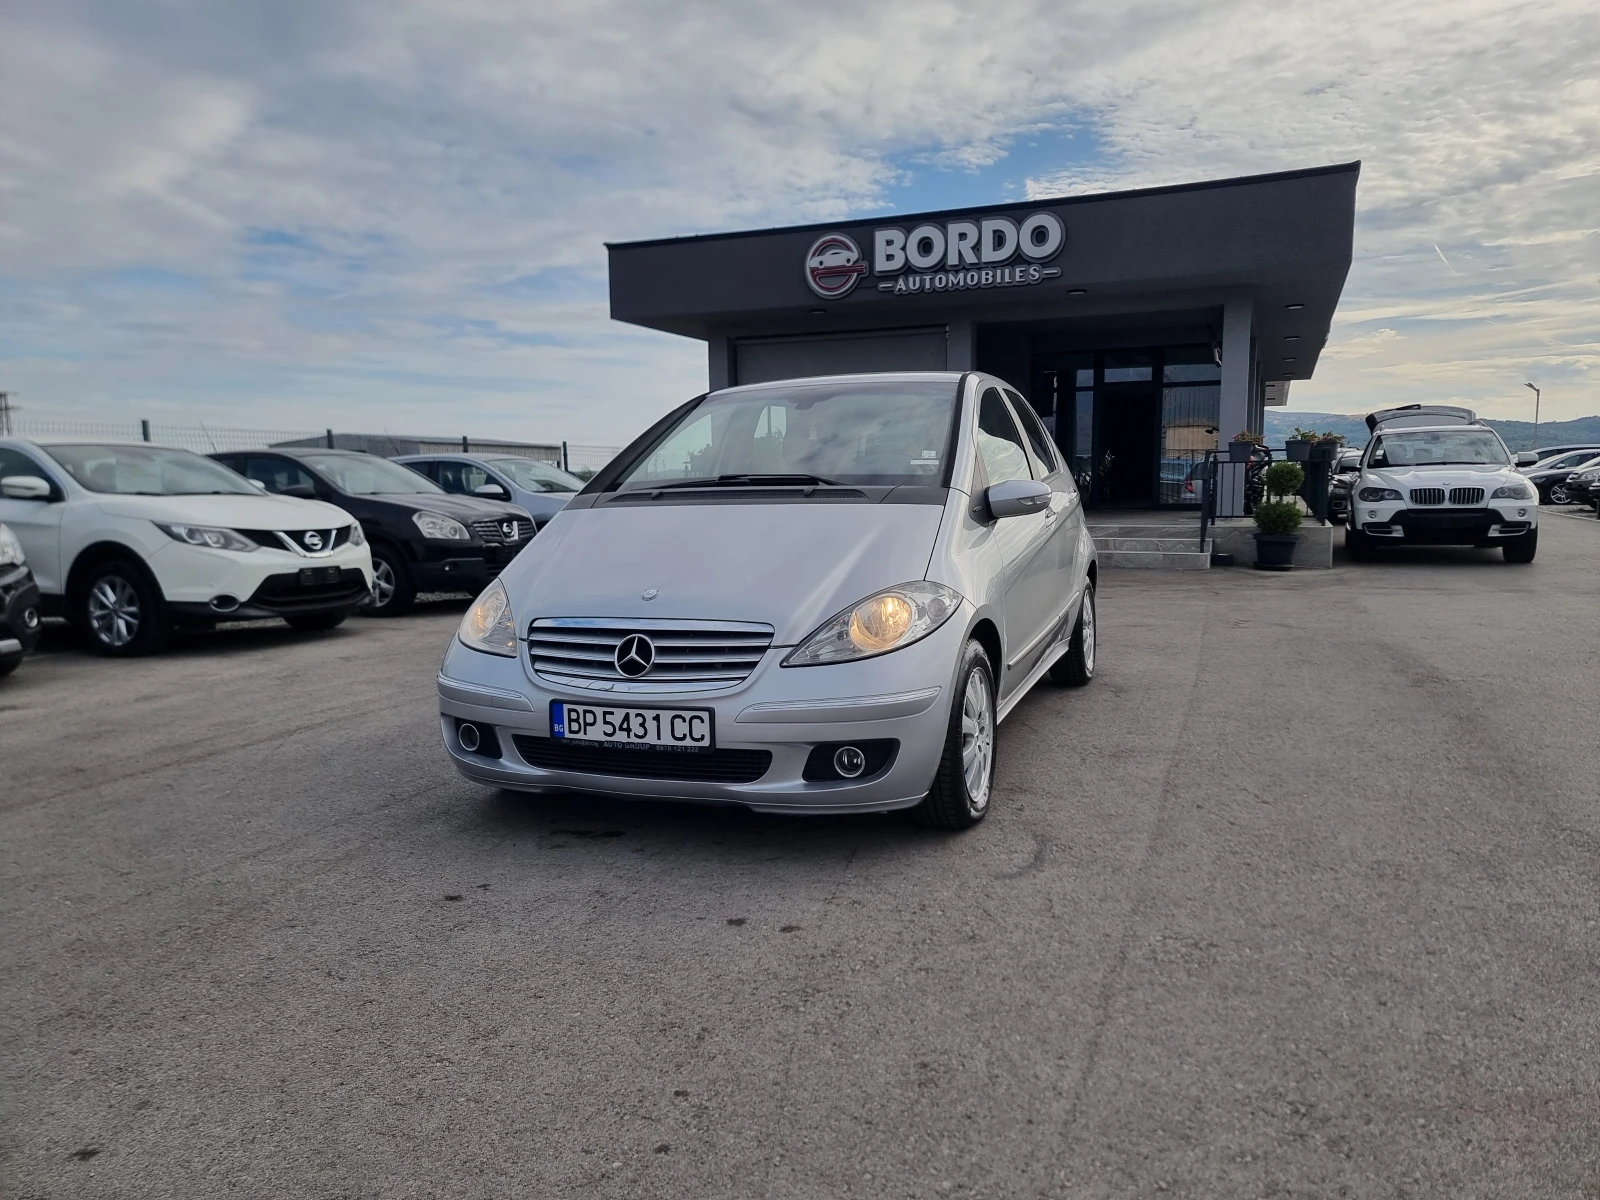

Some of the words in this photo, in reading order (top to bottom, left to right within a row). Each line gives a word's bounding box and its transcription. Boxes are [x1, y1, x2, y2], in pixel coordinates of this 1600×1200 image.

[875, 214, 1062, 272] BORDO
[896, 266, 1041, 292] AUTOMOBILES
[554, 724, 564, 732] BG
[603, 741, 623, 749] AUTO
[624, 742, 650, 750] GROUP
